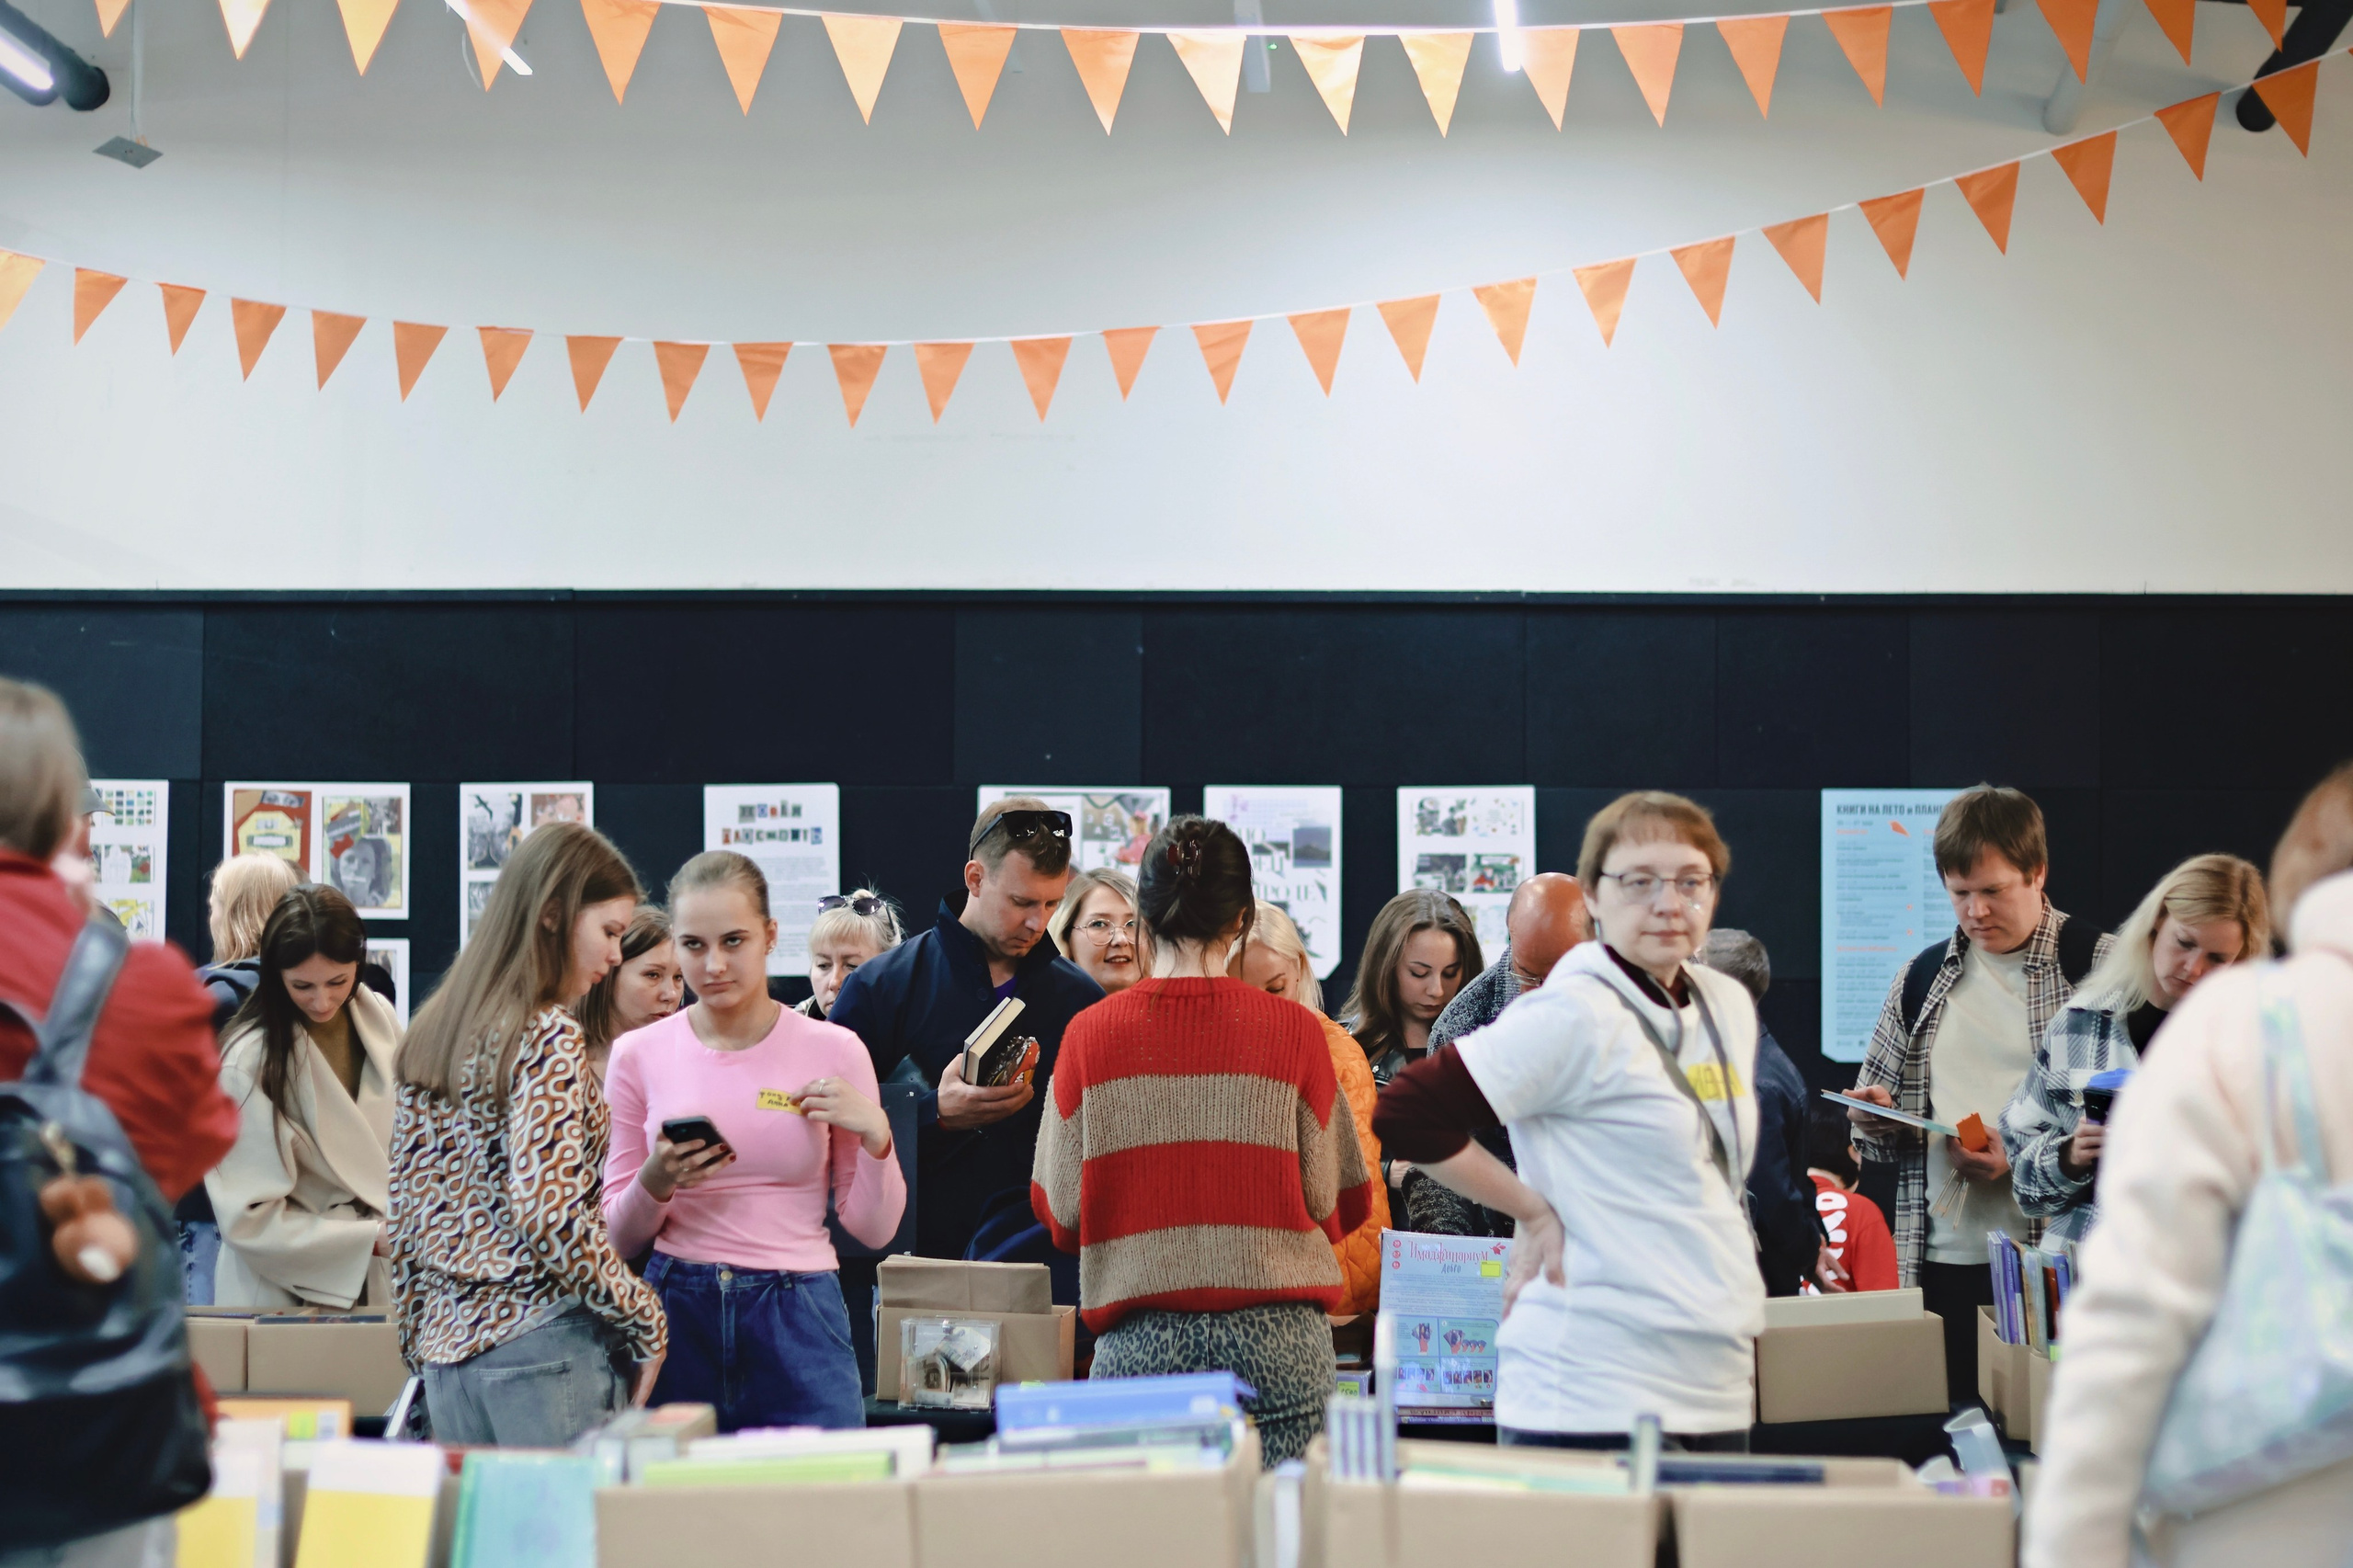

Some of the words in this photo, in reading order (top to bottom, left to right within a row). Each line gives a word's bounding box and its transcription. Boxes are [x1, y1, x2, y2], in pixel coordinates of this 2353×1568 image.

[1836, 804, 1867, 815] КНИГИ
[1869, 804, 1881, 815] НА
[1882, 804, 1905, 815] ЛЕТО
